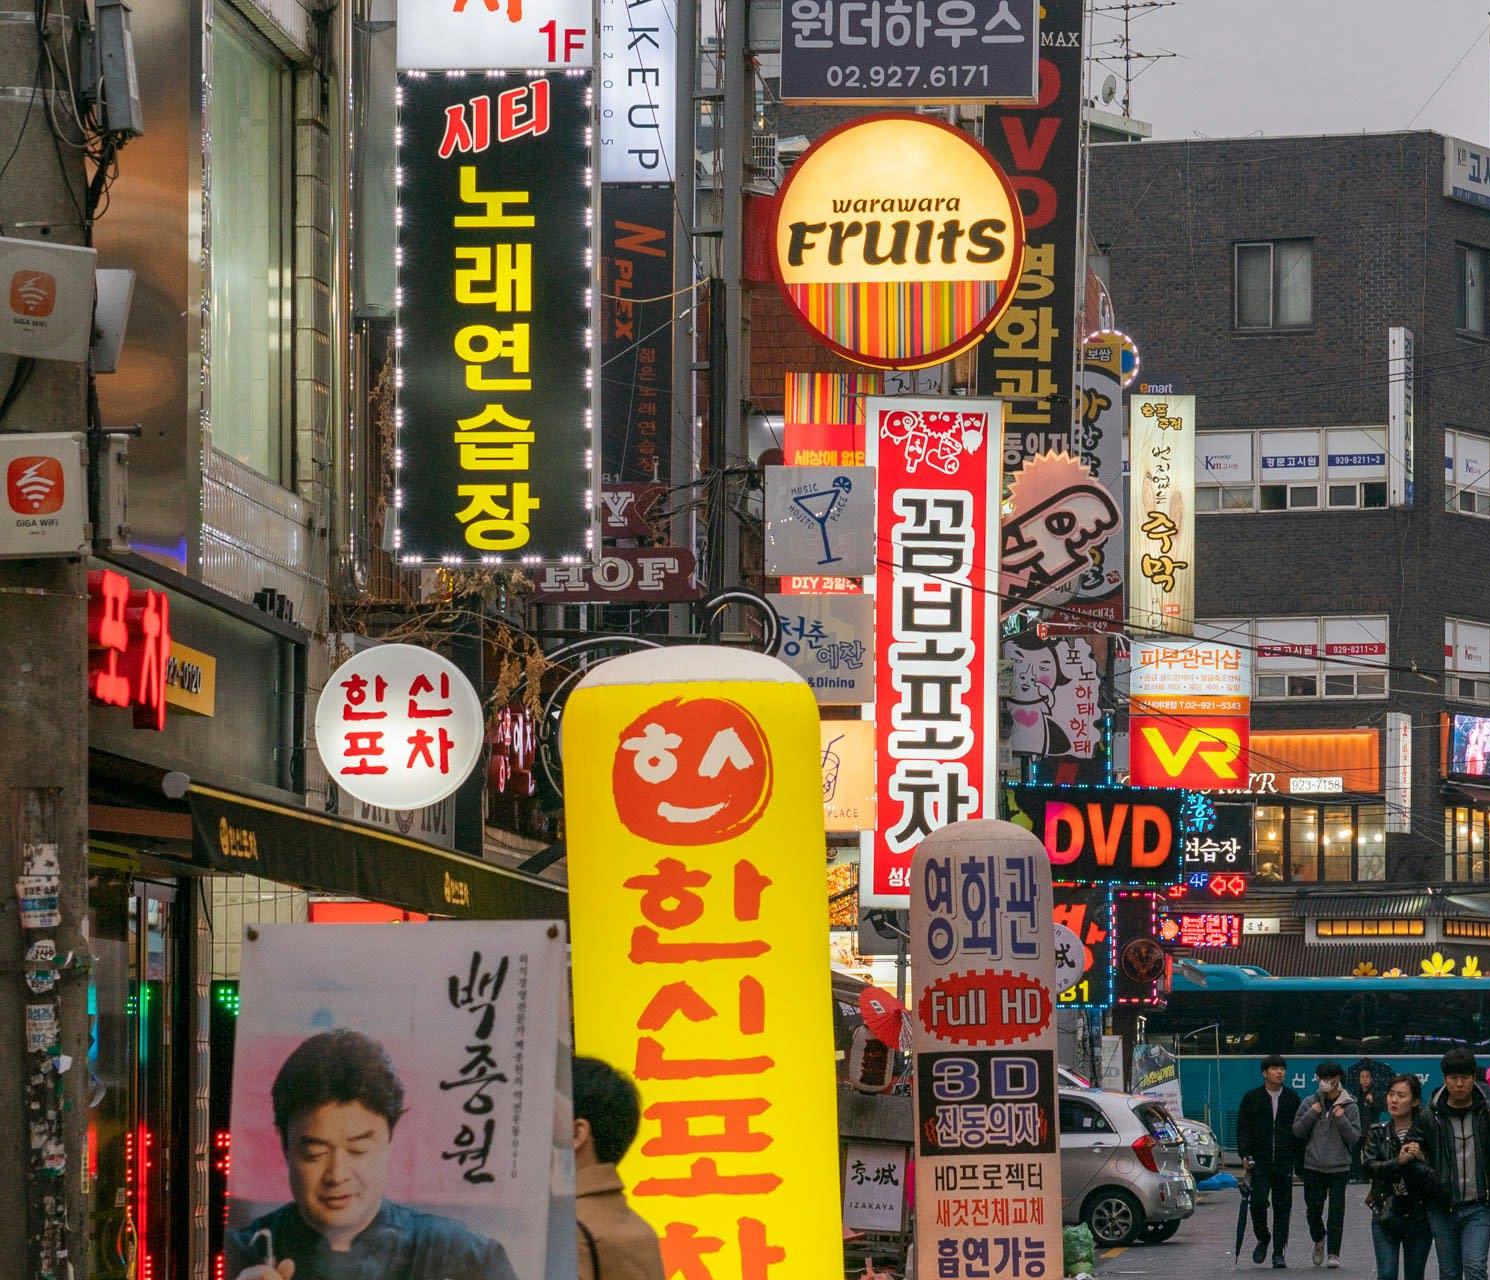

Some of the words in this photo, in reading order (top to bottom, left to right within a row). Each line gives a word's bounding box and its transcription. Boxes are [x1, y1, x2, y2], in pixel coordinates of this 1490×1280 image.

[538, 19, 587, 63] 1F
[790, 0, 1026, 50] 원더하우스
[826, 65, 990, 90] 02.927.6171
[438, 78, 551, 160] 시티
[831, 194, 961, 215] warawara
[614, 258, 634, 342] PLEX
[452, 164, 541, 552] 노래연습장
[1139, 383, 1174, 395] emart
[1335, 455, 1381, 465] 929-8211~2
[790, 484, 818, 497] MUSIC
[1140, 510, 1189, 594] 주막
[791, 576, 820, 590] DIY
[781, 615, 829, 656] 청춘
[816, 639, 866, 670] 예찬
[1333, 645, 1379, 655] 929-8211~2
[1140, 648, 1242, 671] 피부관리샵
[340, 671, 454, 721] 한신
[340, 727, 455, 775] 포차
[1140, 727, 1241, 780] VR
[1291, 778, 1342, 792] 923-7158
[1045, 800, 1174, 869] DVD
[1189, 873, 1208, 888] 4F
[924, 856, 1040, 965] 영화관
[930, 990, 987, 1028] Full
[1001, 987, 1042, 1025] HD
[439, 950, 510, 1185] 백종원
[934, 1102, 1041, 1148] 진동의자
[934, 1162, 1044, 1194] HD프로젝터
[850, 1200, 895, 1212] IZAKAYA
[935, 1195, 1045, 1227] 새것전체교체
[936, 1235, 1046, 1280] 흡연가능
